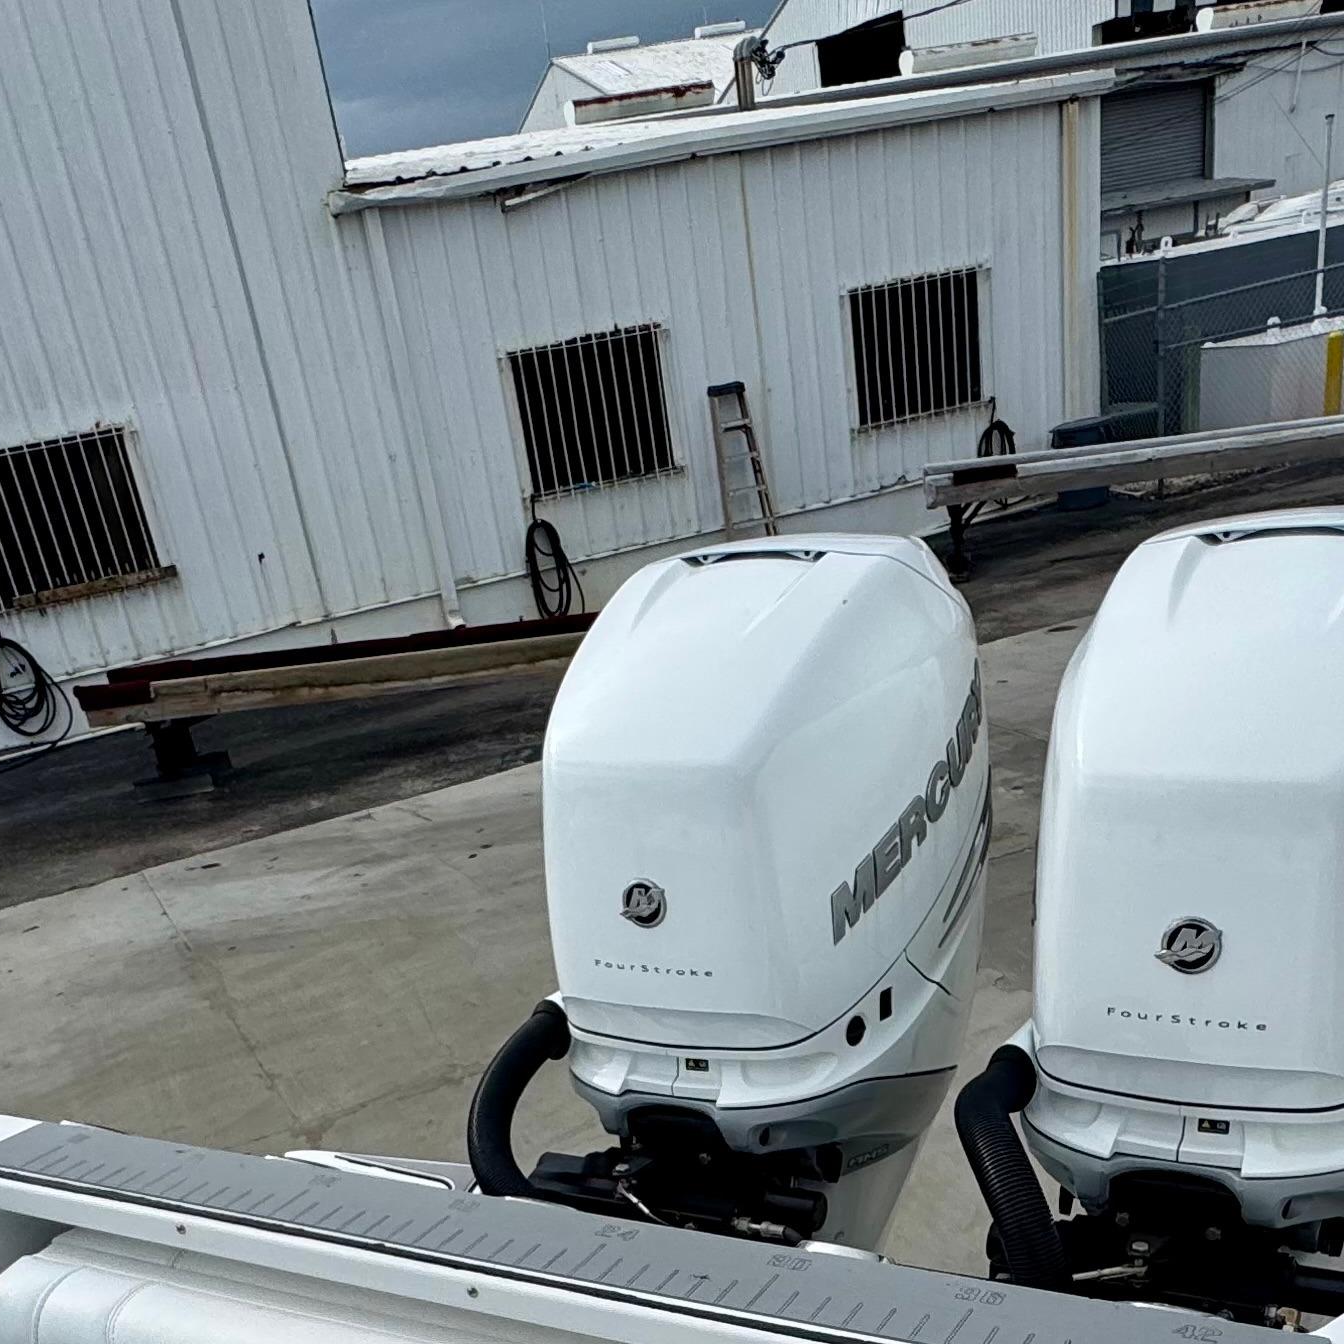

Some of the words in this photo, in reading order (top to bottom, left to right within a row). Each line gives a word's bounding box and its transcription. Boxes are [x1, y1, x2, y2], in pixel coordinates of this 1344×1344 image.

[594, 958, 713, 978] FourStroke
[1106, 1006, 1268, 1032] FourStroke
[1171, 1322, 1224, 1344] 42
